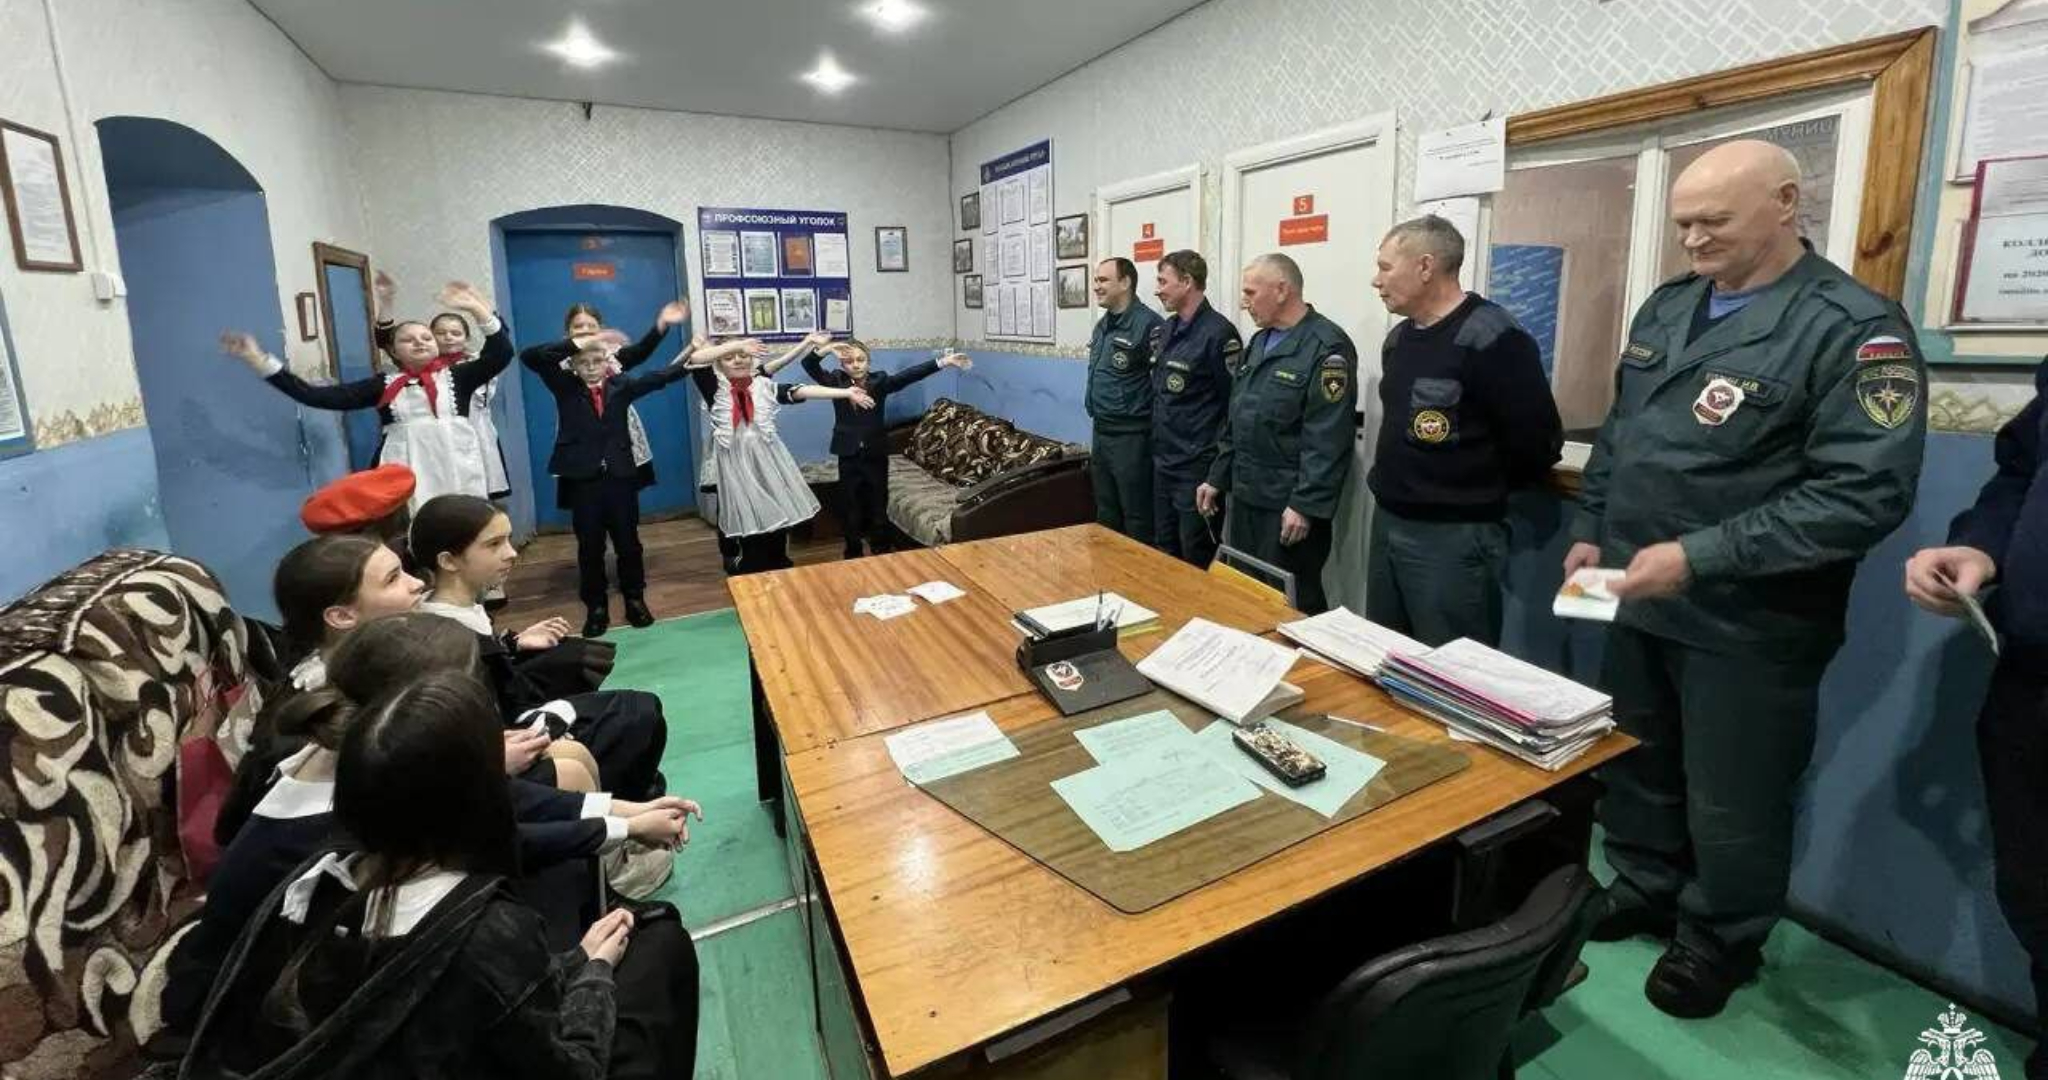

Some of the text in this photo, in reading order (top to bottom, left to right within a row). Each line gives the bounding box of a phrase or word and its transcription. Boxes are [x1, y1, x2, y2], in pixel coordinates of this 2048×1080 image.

[1299, 198, 1307, 212] 5
[714, 213, 836, 227] ПРОФСОЮЗНЫЙ УГОЛОК
